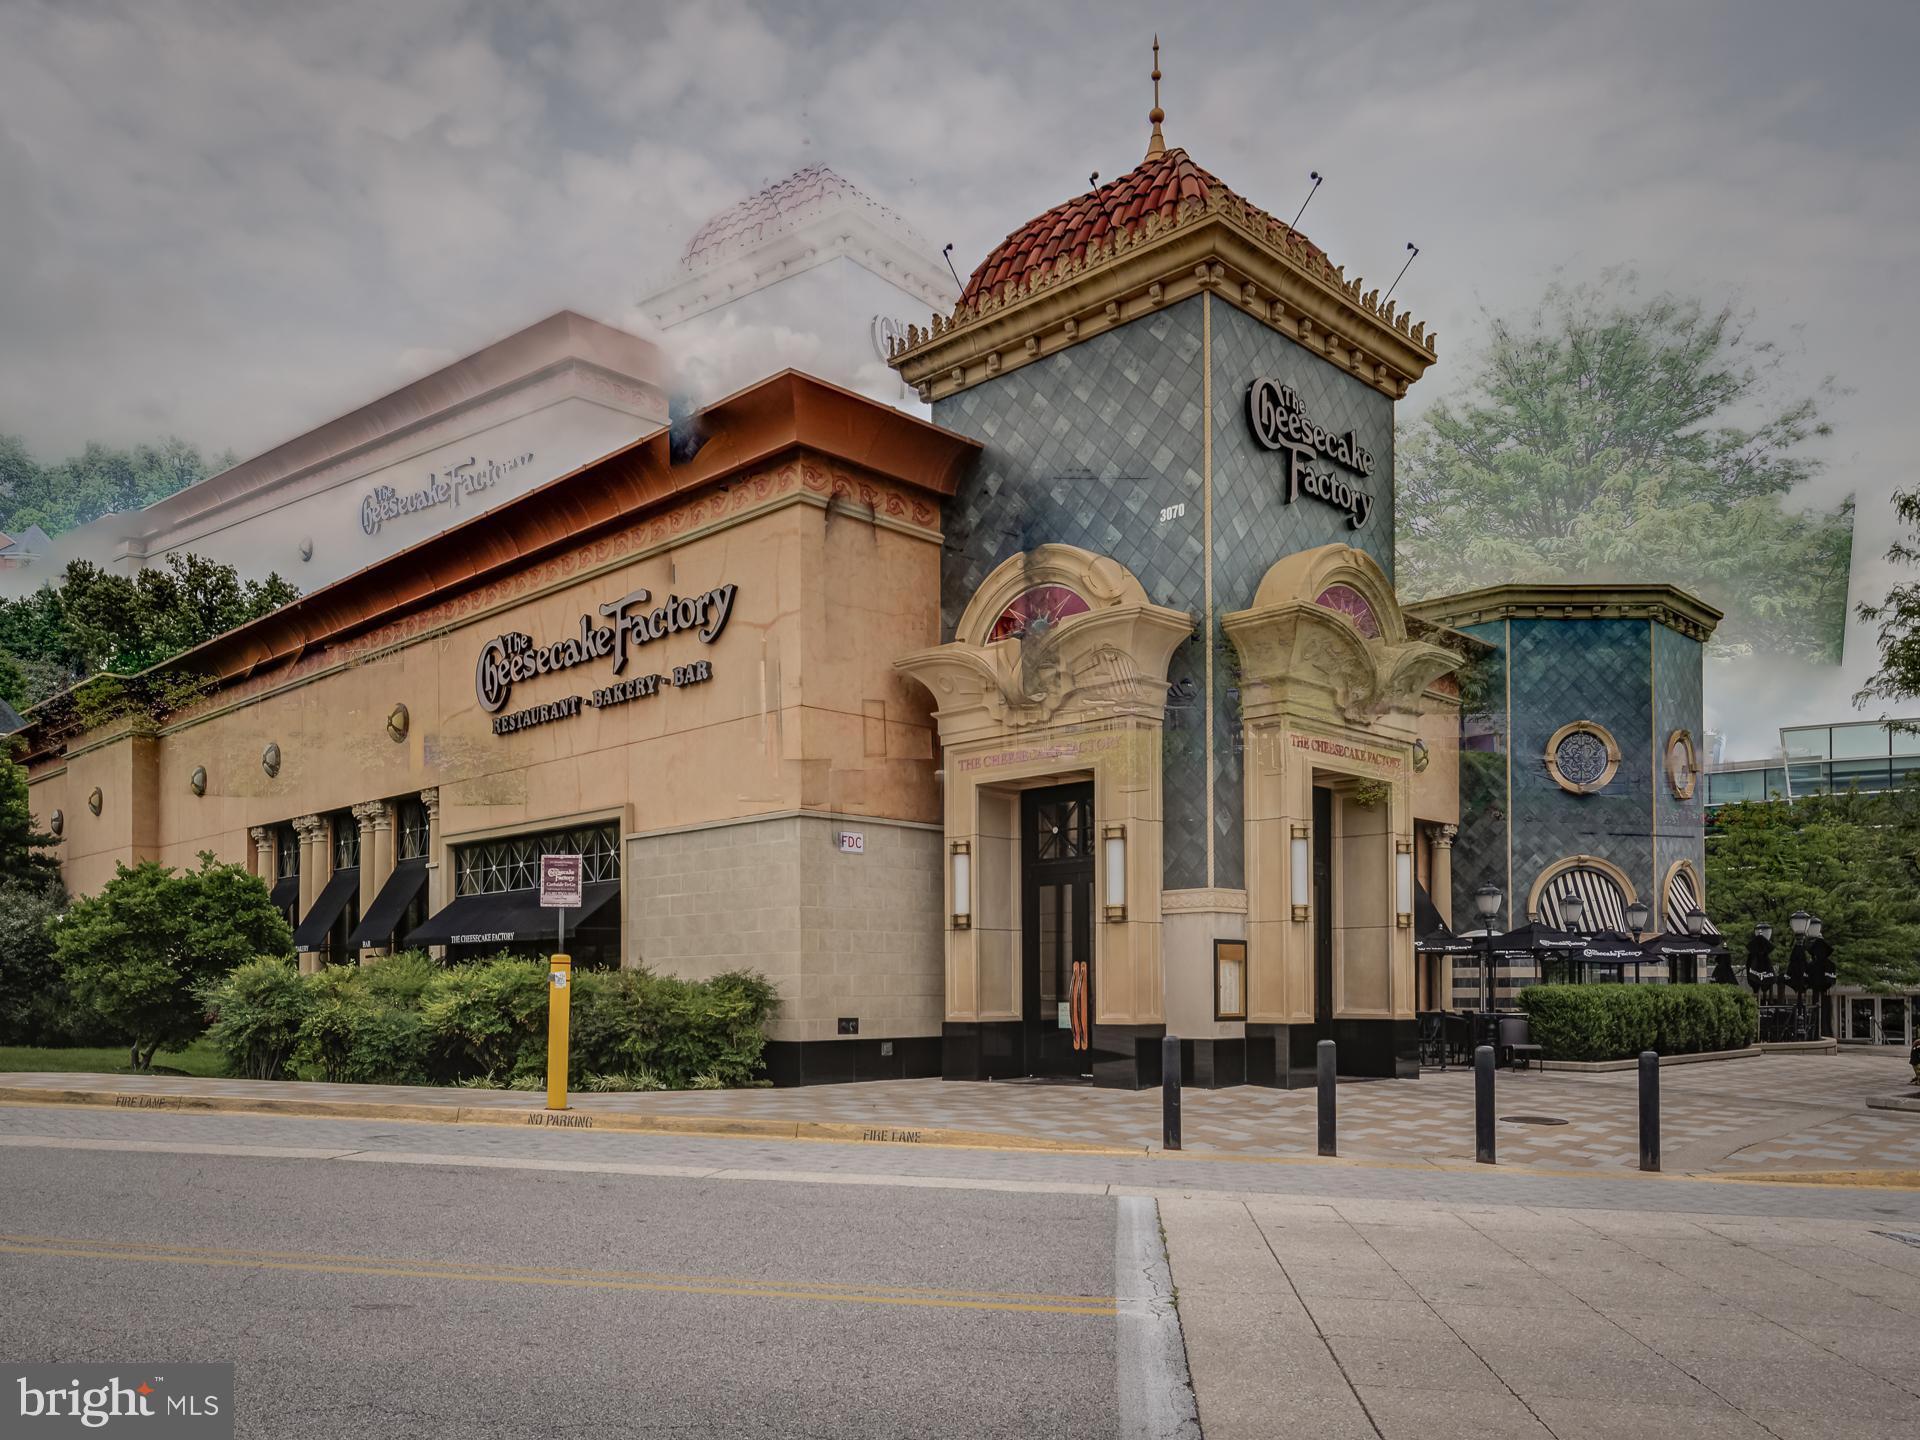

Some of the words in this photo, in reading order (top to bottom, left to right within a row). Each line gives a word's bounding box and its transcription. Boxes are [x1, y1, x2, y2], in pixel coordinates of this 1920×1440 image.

[1282, 385, 1306, 414] The
[1245, 376, 1376, 477] Cheesecake
[1278, 432, 1374, 530] Factory
[1160, 503, 1185, 522] 3070
[475, 614, 613, 713] Cheesecake
[599, 583, 738, 675] Factory
[505, 631, 532, 656] The
[492, 695, 582, 735] RESTAURANT
[592, 674, 660, 708] BAKERY
[673, 660, 713, 687] BAR
[1291, 734, 1310, 749] THE
[1311, 739, 1366, 762] CHEESECAKE
[958, 757, 981, 771] THE
[841, 835, 862, 849] FDC
[451, 935, 460, 944] THE
[461, 933, 491, 943] CHEESECAKE
[492, 932, 515, 941] FACTORY
[115, 1096, 137, 1107] FIRE
[140, 1097, 165, 1108] LANE
[528, 1113, 543, 1125] NO
[546, 1114, 593, 1128] PARKING
[863, 1129, 888, 1142] FIRE
[892, 1131, 921, 1143] LANE
